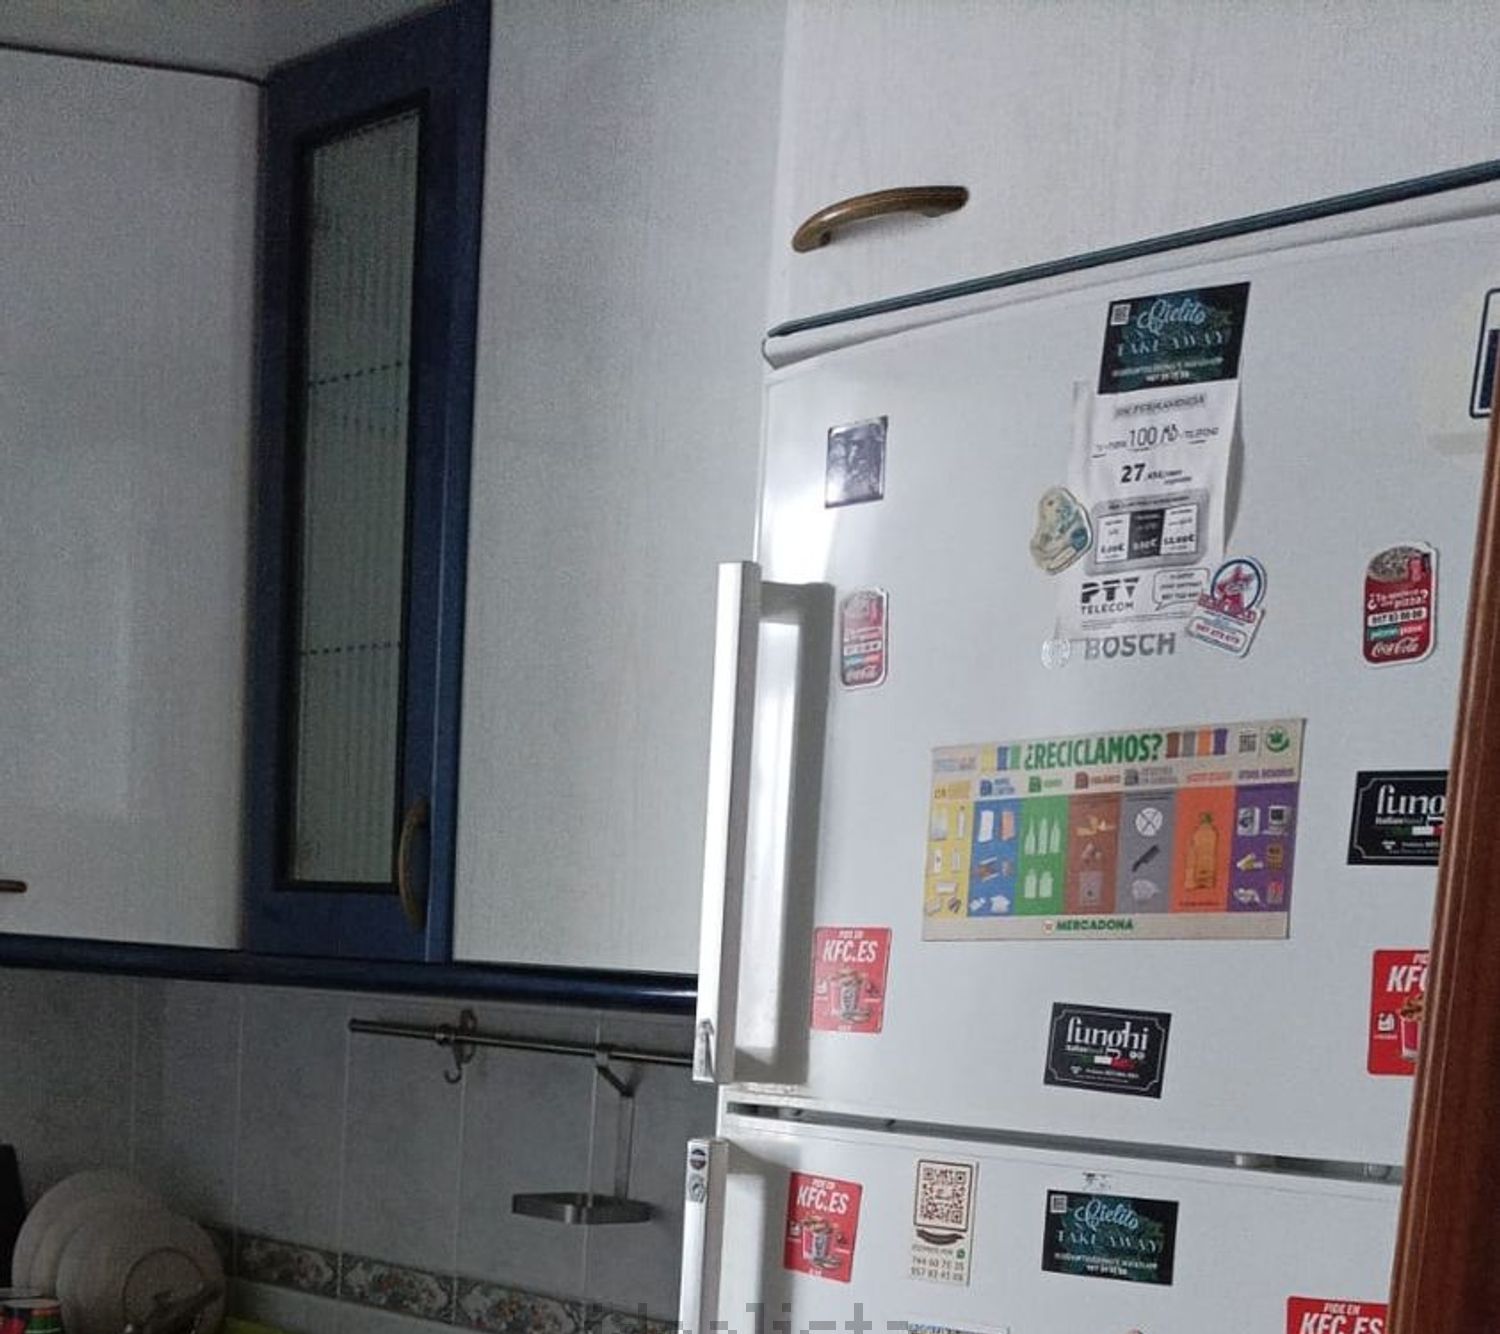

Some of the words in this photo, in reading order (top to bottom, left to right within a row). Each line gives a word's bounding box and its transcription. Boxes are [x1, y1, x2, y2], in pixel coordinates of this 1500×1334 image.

[1121, 462, 1146, 483] 27
[1082, 602, 1134, 615] TELECOM
[1085, 631, 1177, 660] BOSCH
[1023, 733, 1163, 771] ¿RECICLAMOS?
[1056, 919, 1134, 931] MERCADONA
[824, 940, 878, 963] KFC.ES
[1067, 1016, 1149, 1060] funghi
[796, 1185, 850, 1216] KFC.ES
